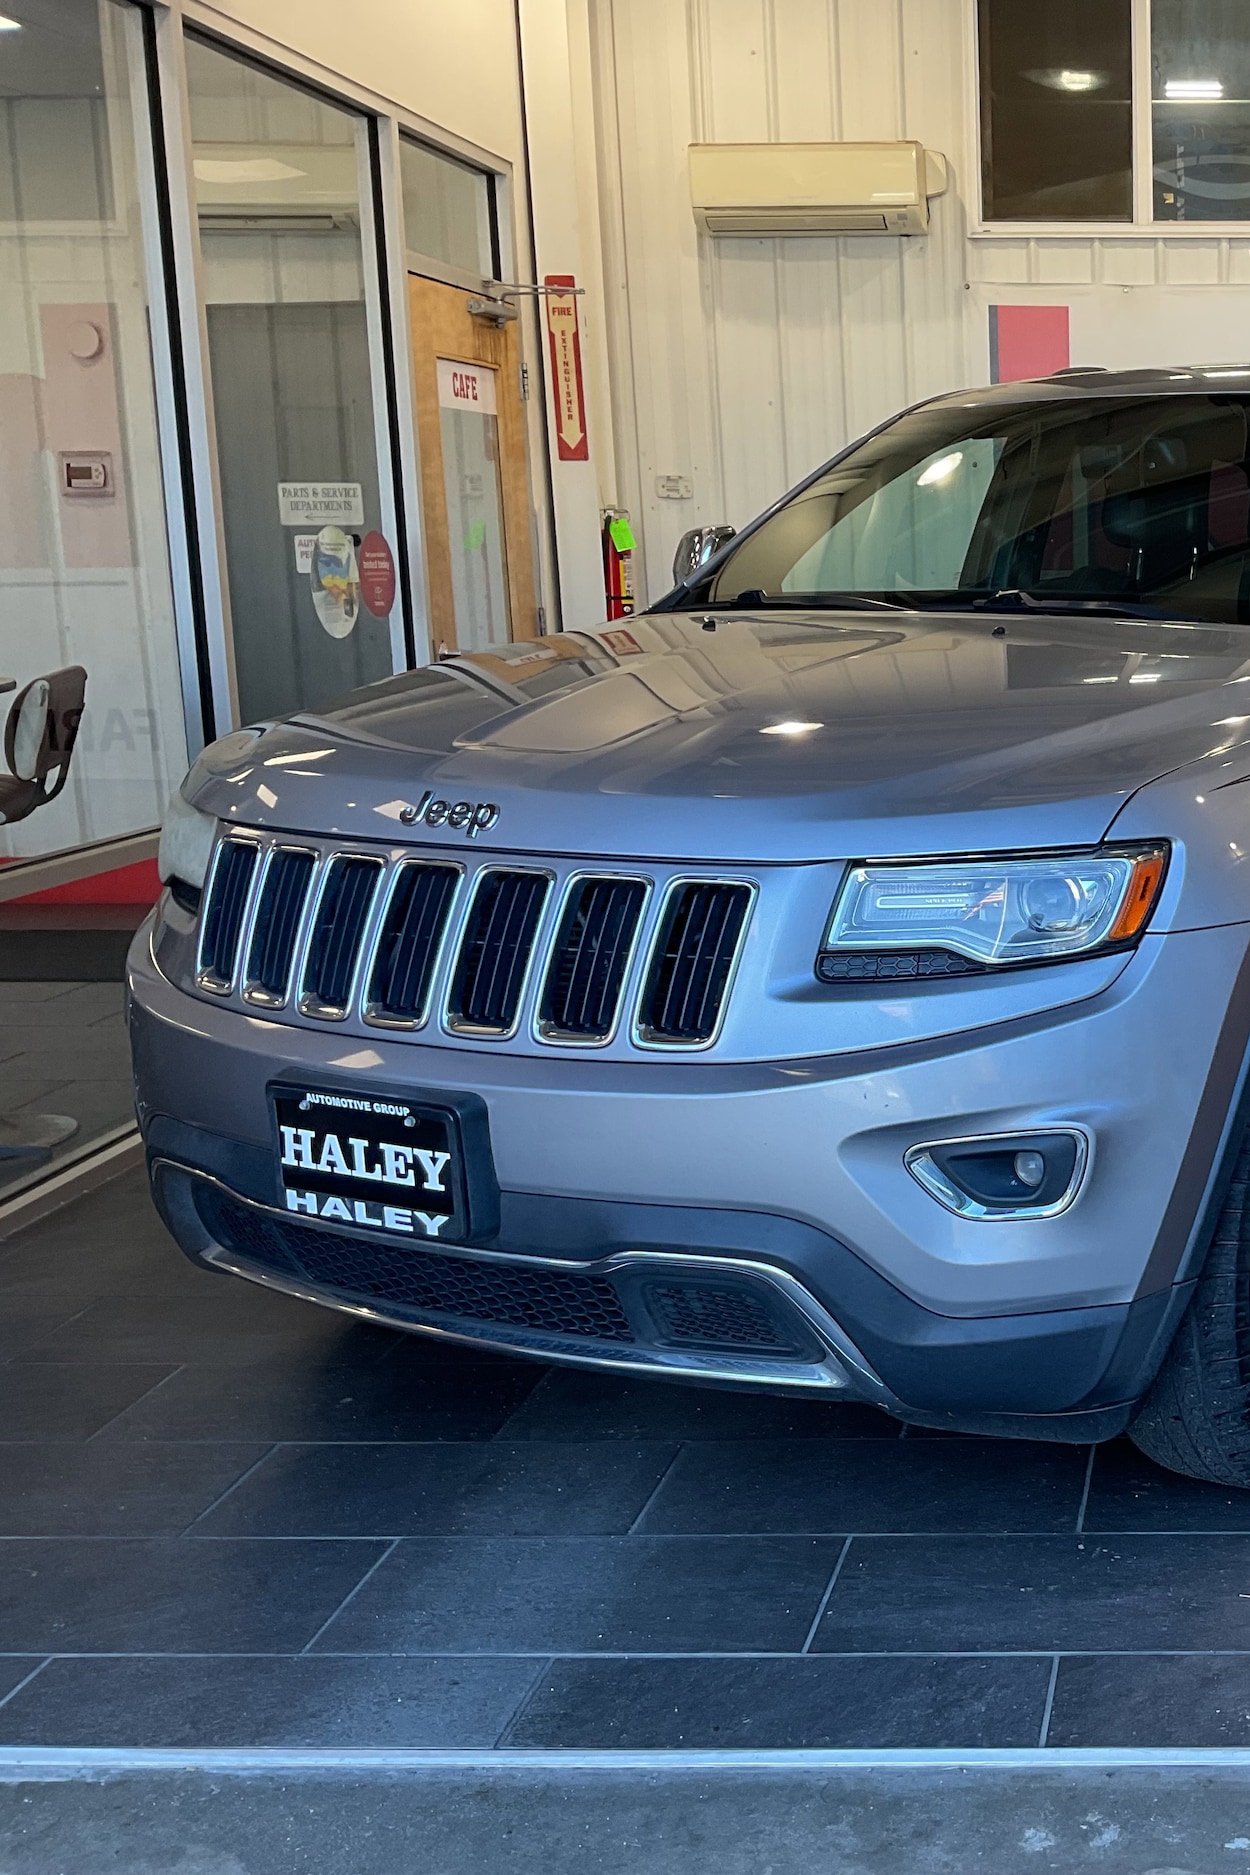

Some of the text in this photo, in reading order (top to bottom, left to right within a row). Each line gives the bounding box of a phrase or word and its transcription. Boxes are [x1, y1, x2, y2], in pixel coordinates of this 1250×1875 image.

[552, 307, 572, 316] FIRE
[452, 371, 478, 400] CAFE
[561, 330, 573, 420] EXTINGUISHER
[281, 488, 359, 498] PARTS & SERVICE
[290, 501, 353, 511] DEPARTMENTS
[400, 790, 500, 839] Jeep
[305, 1092, 410, 1117] AUTOMOTIVE GROUP
[280, 1125, 451, 1192] HALEY
[285, 1188, 450, 1236] HALEY
